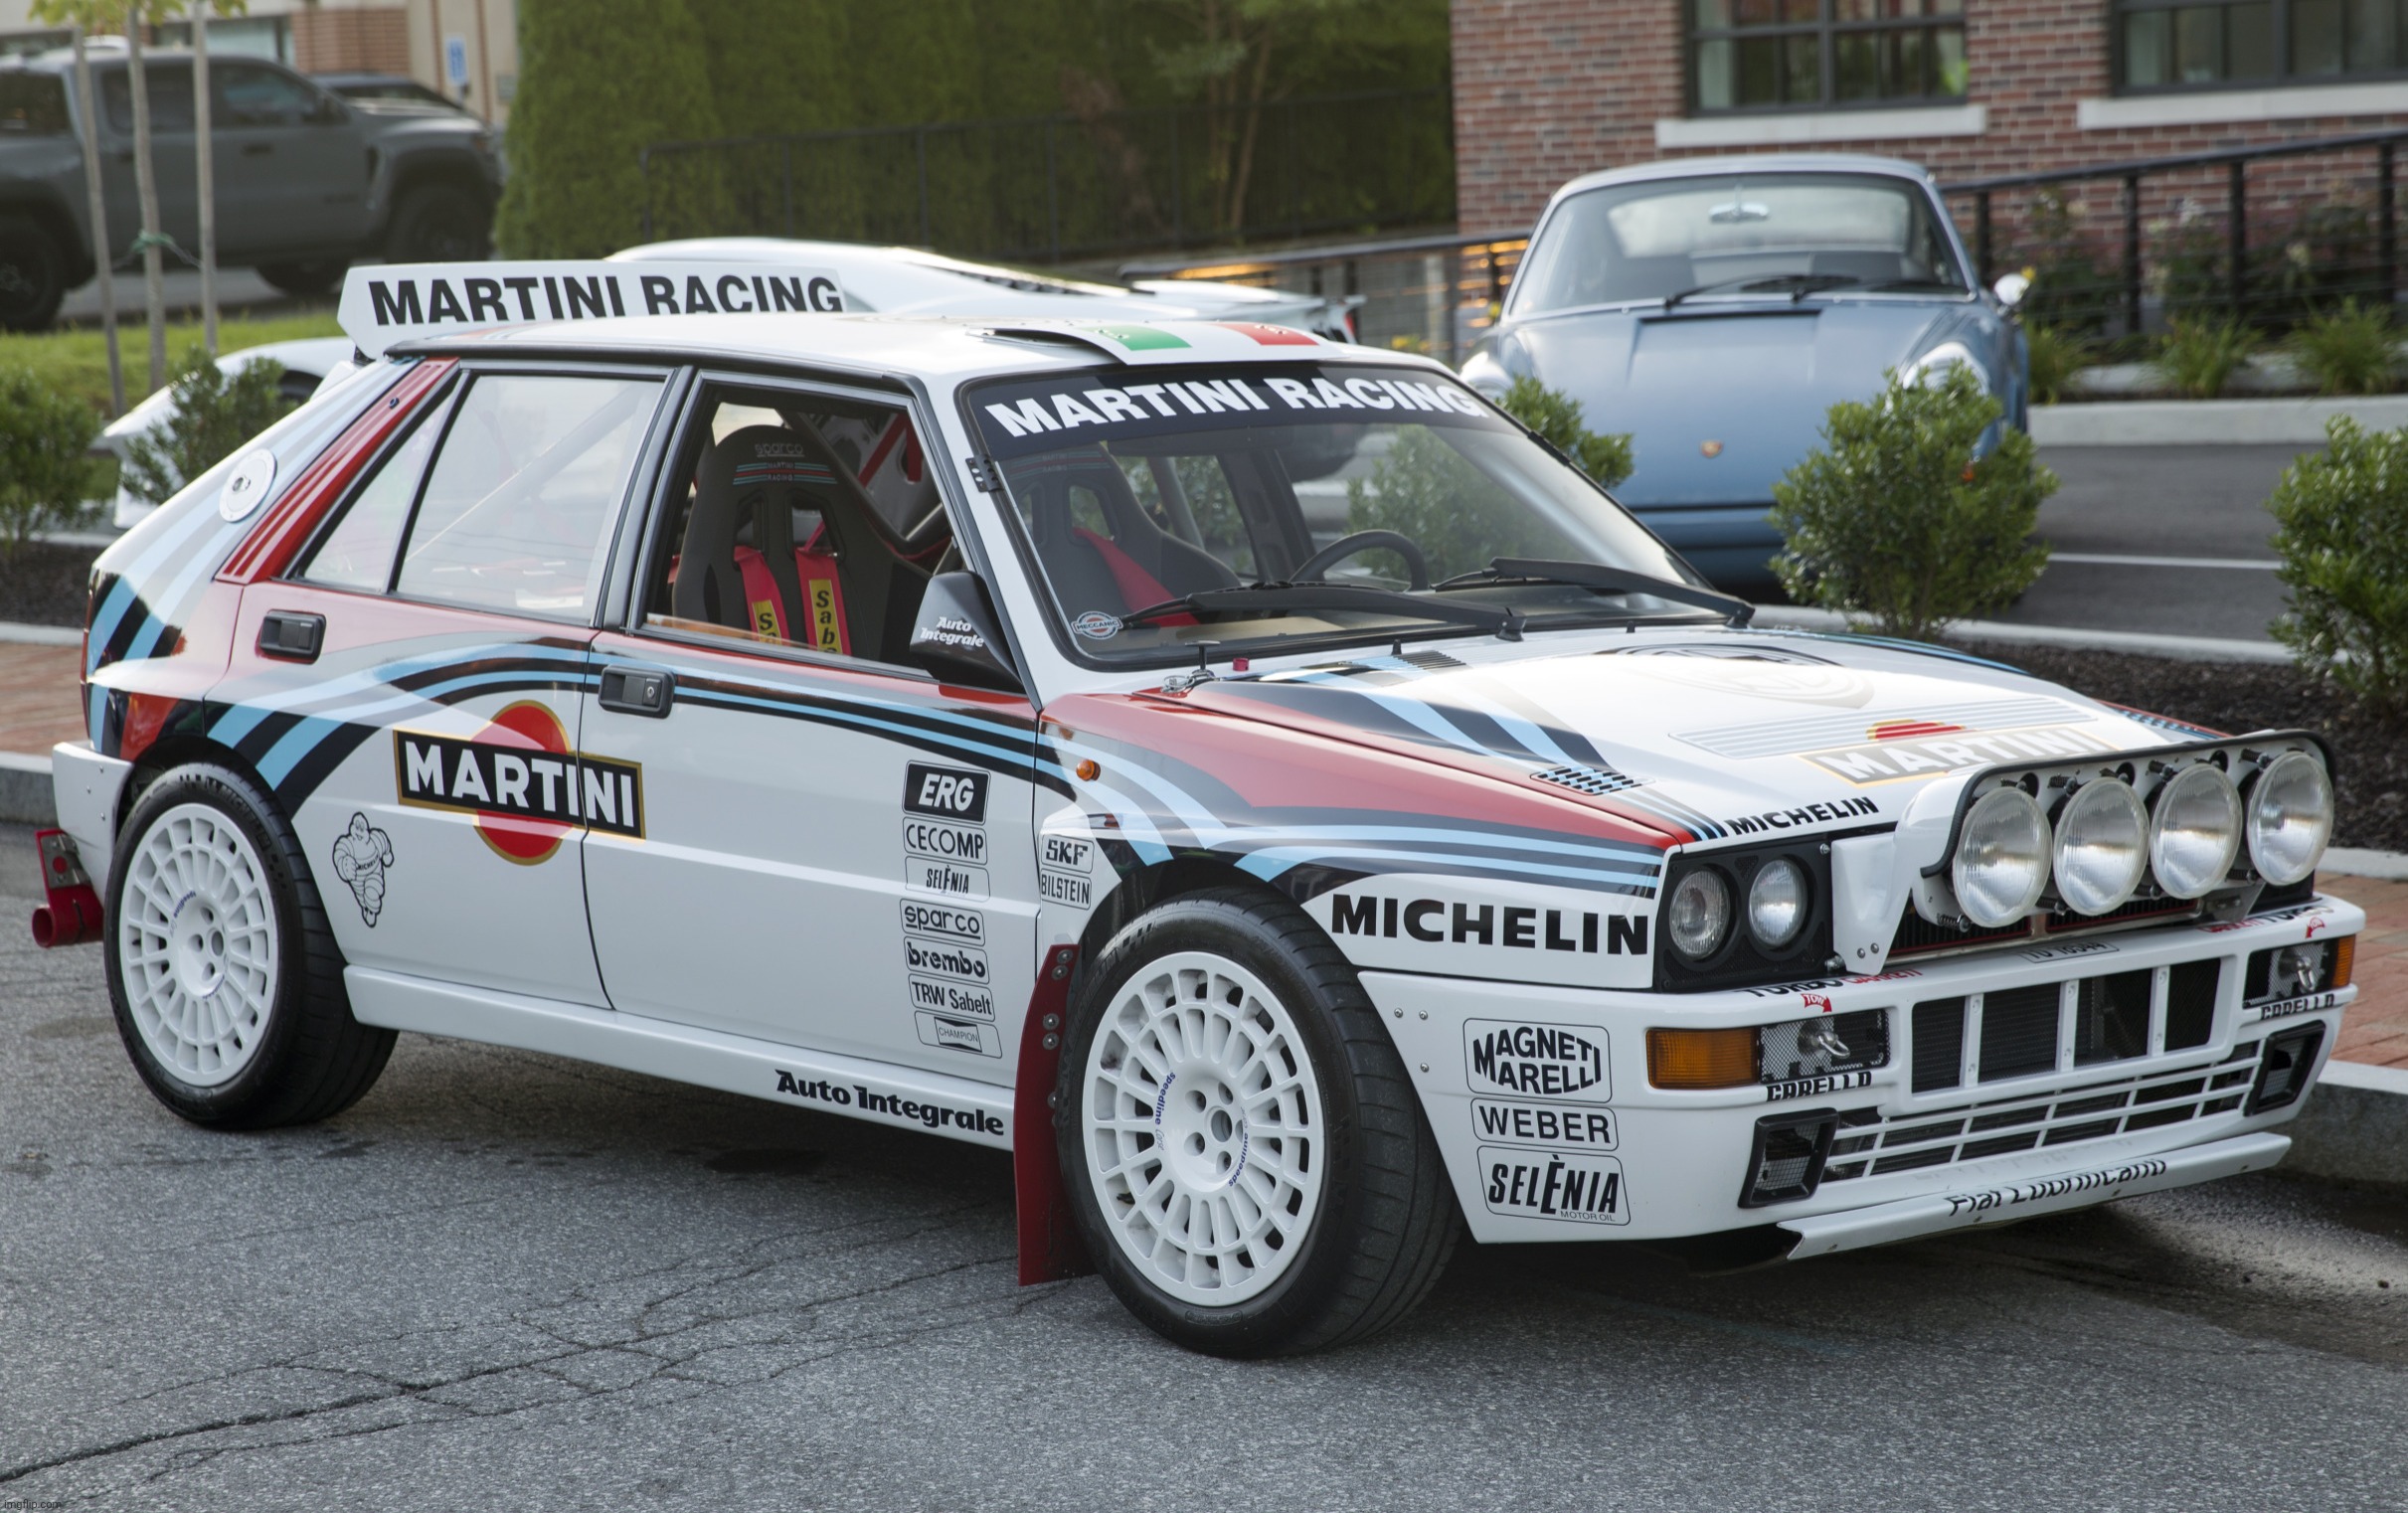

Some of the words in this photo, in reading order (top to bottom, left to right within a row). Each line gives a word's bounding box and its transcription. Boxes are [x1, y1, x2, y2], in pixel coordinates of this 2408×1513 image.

[368, 275, 625, 327] MARTINI
[640, 274, 844, 315] RACING
[984, 379, 1271, 437] MARTINI
[1263, 377, 1489, 418] RACING
[920, 627, 985, 648] Integrale
[936, 616, 972, 632] Auto
[1815, 728, 2106, 779] MARTINI
[405, 741, 634, 828] MARTINI
[919, 772, 974, 812] ERG
[1724, 795, 1879, 836] MICHELIN
[906, 823, 984, 859] CECOMP
[1046, 839, 1088, 866] SKF
[926, 865, 969, 895] SELÈNIA
[1041, 874, 1090, 905] BILSTEIN
[904, 906, 980, 936] sparco
[1331, 894, 1647, 955] MICHELIN
[907, 942, 985, 977] brembo
[912, 981, 946, 1006] TRW
[948, 988, 992, 1016] Sabelt
[1806, 994, 1824, 1005] TOW
[939, 1026, 978, 1044] CHAMPION
[1472, 1026, 1602, 1072] MAGNETI
[1472, 1054, 1602, 1094] MARELLI
[774, 1069, 851, 1105] Auto
[852, 1085, 1004, 1136] Integrale
[1154, 1072, 1176, 1125] speedline
[1478, 1105, 1611, 1143] WEBER
[1228, 1133, 1249, 1187] speedline
[1488, 1154, 1620, 1215] SELÈNIA
[1560, 1211, 1598, 1221] MOTOR
[1599, 1213, 1616, 1222] OIL
